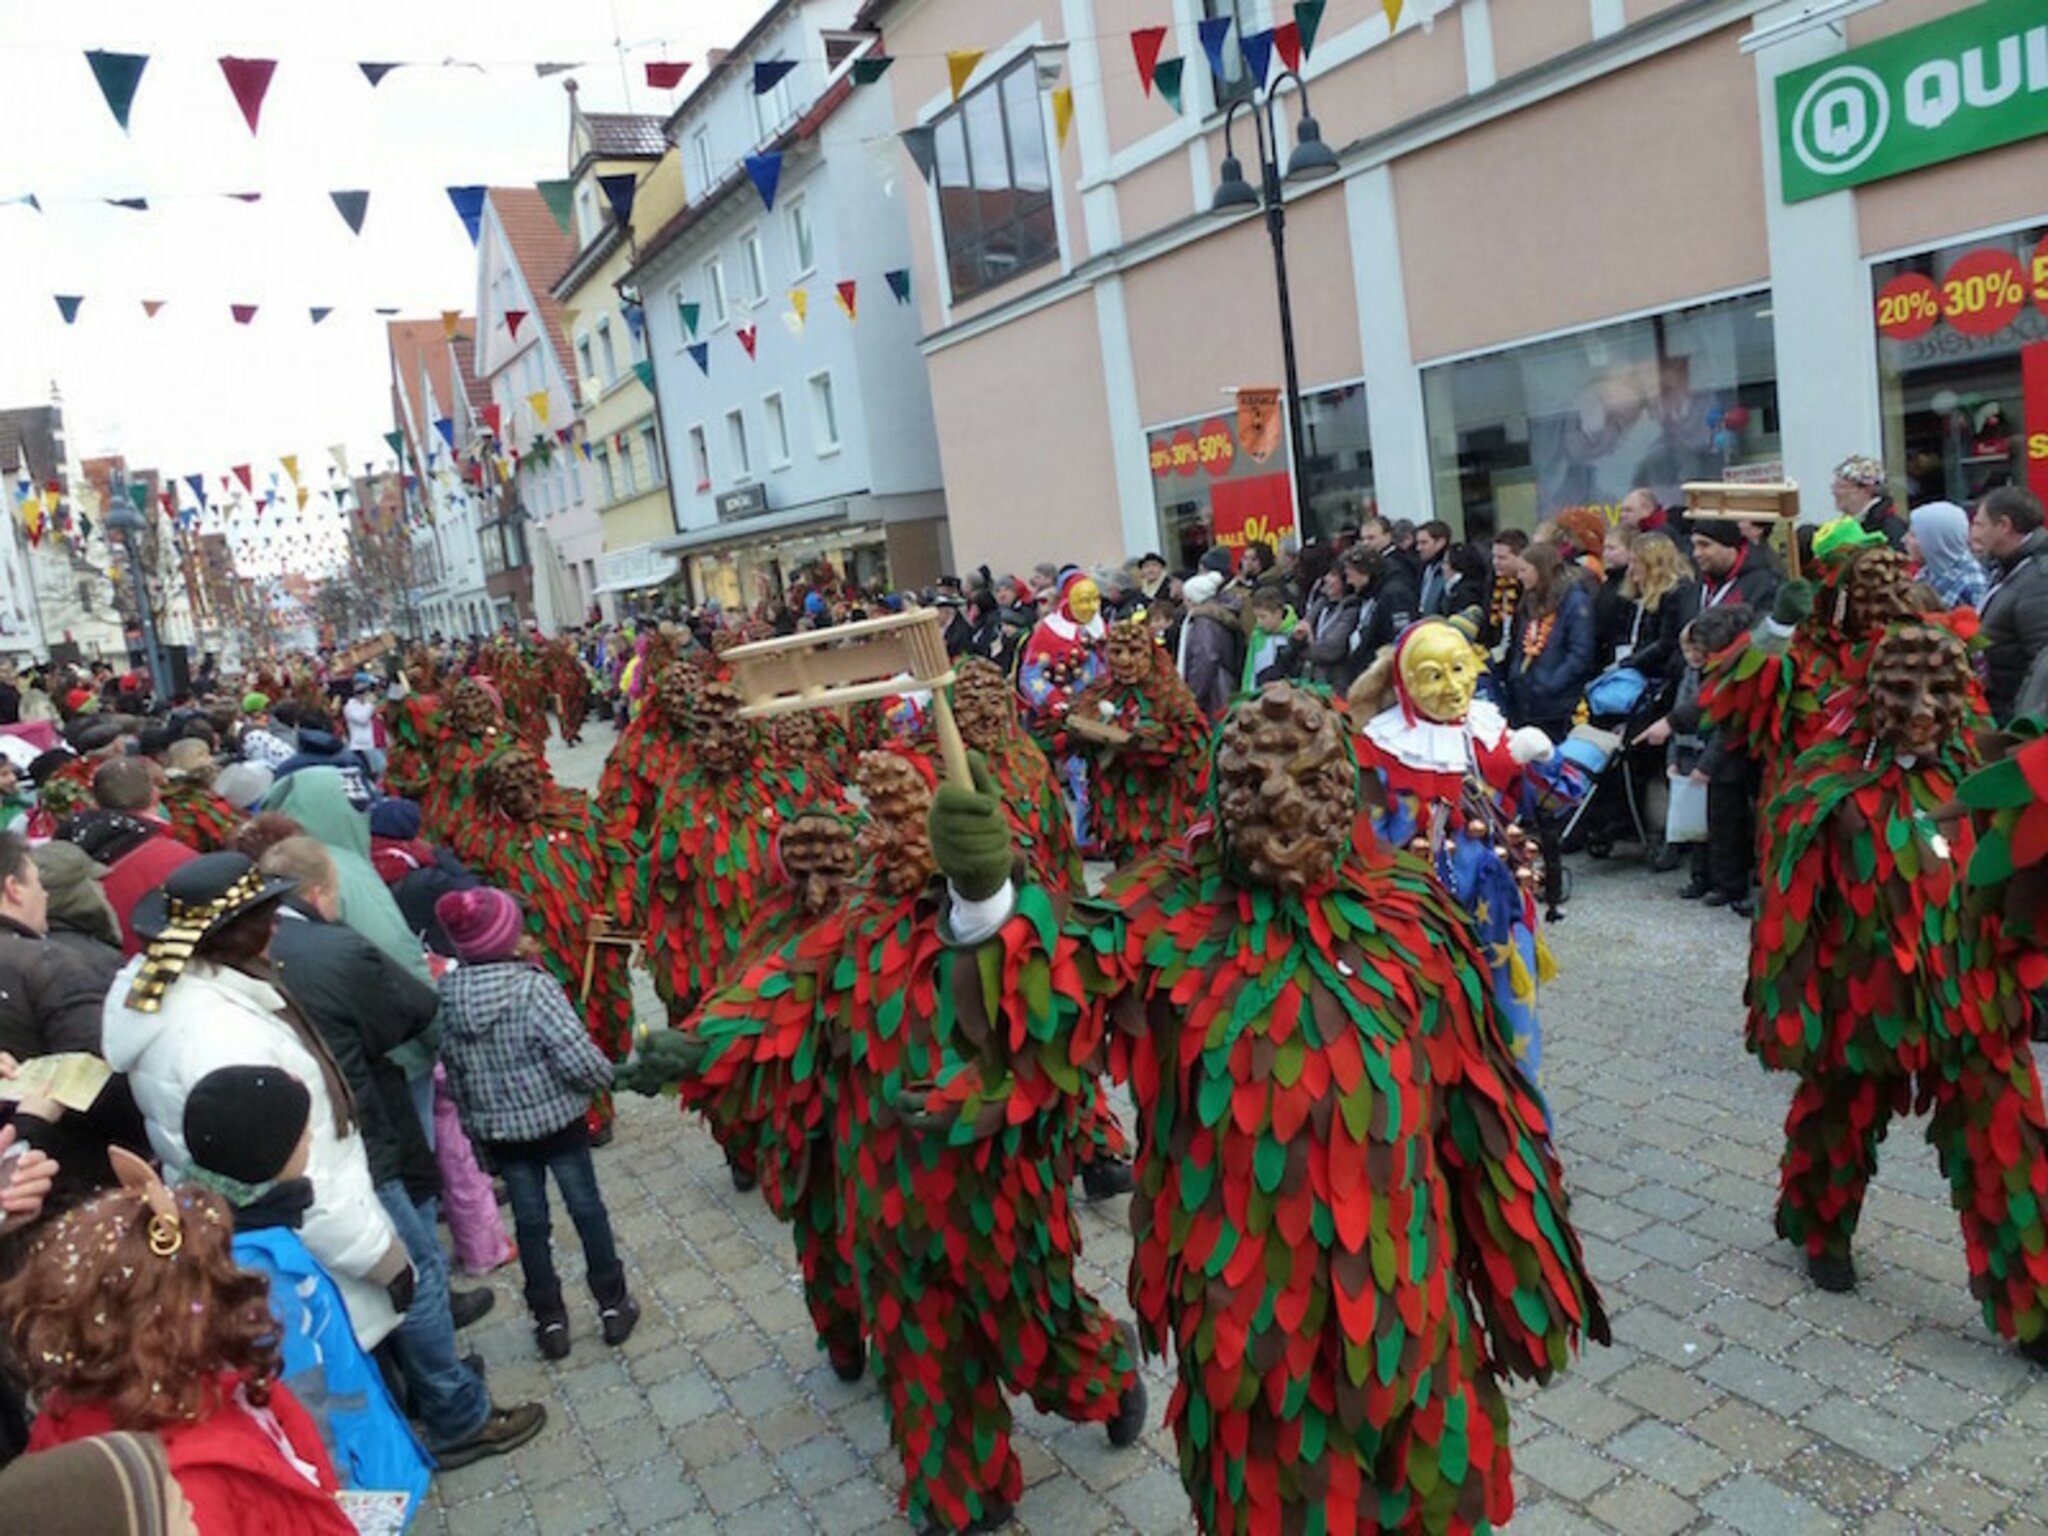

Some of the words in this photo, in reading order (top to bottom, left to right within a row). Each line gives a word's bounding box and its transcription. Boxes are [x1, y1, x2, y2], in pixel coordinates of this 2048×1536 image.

[1878, 290, 1938, 326] 20%
[1943, 269, 2023, 317] 30%
[1171, 443, 1198, 466] 30%
[1199, 433, 1233, 462] 50%
